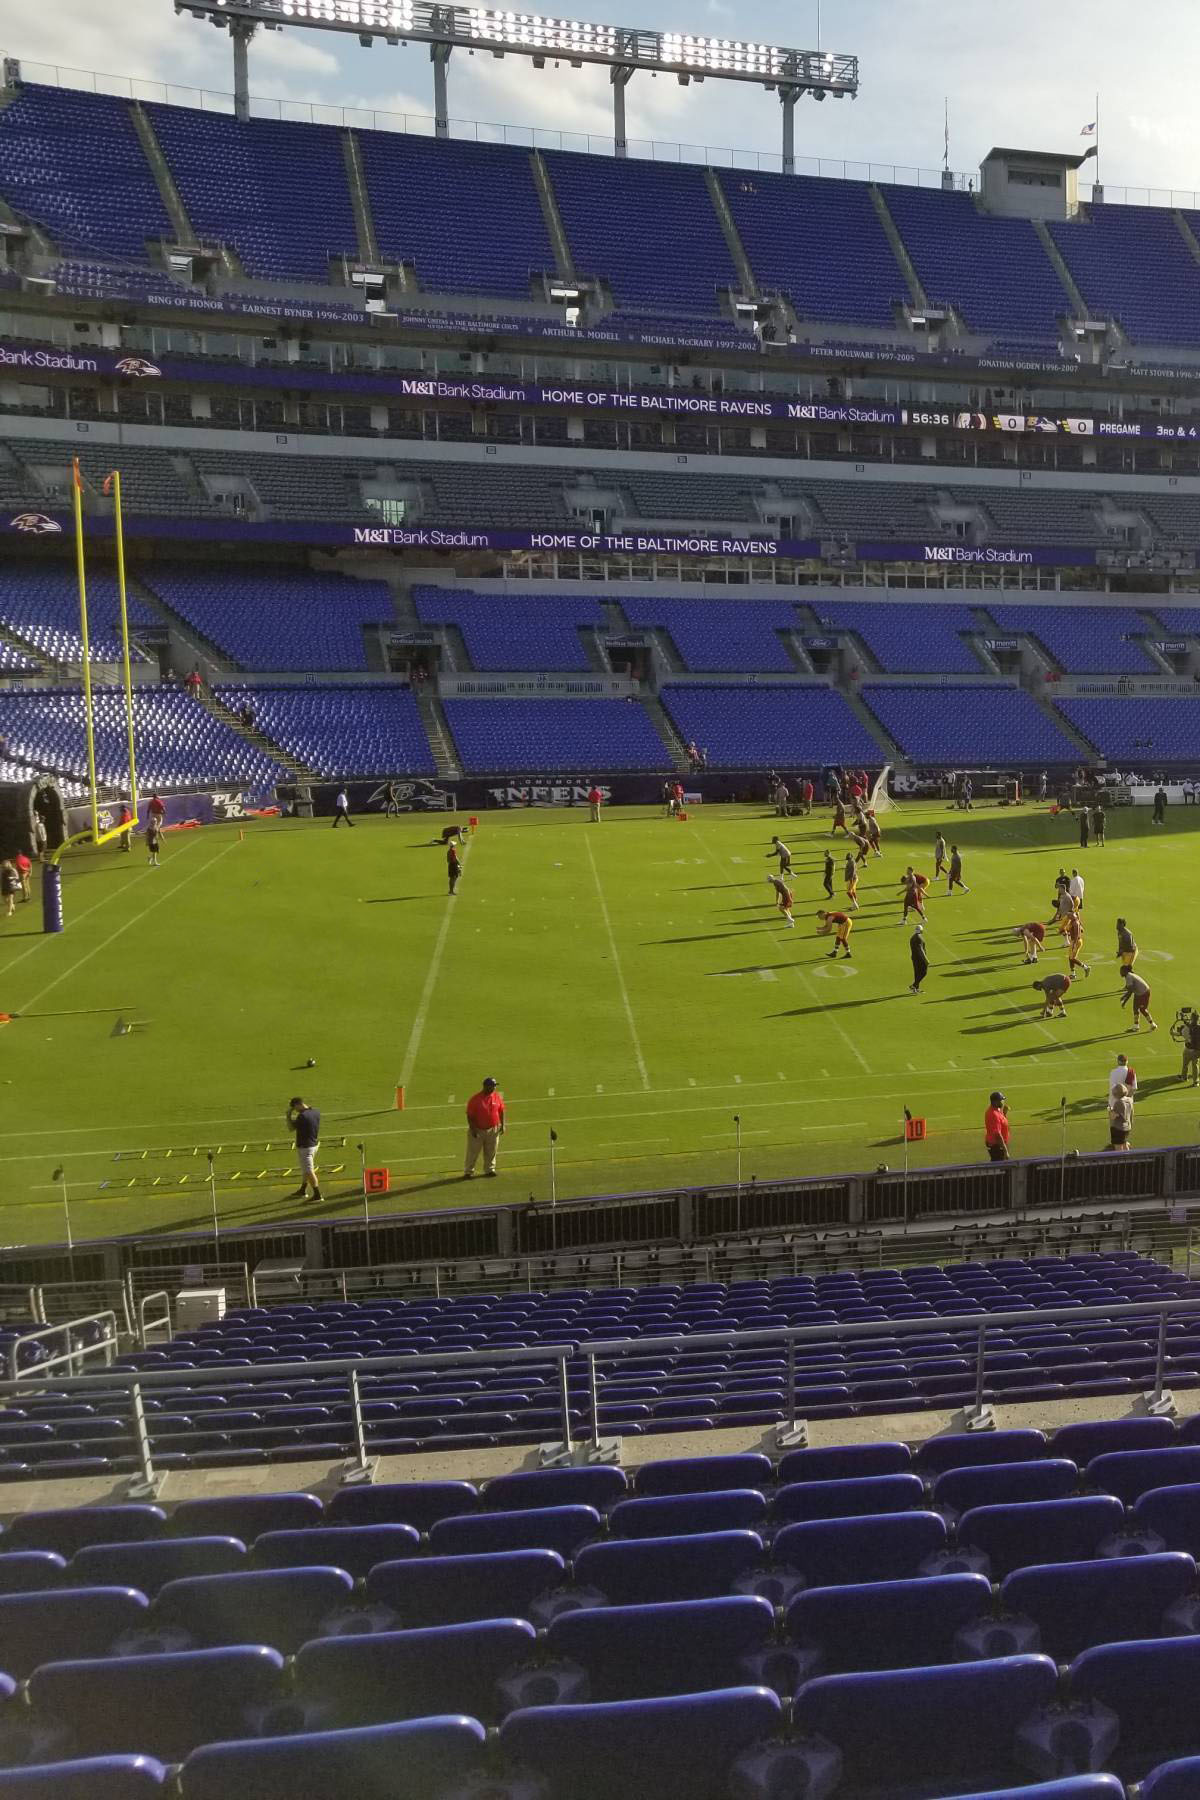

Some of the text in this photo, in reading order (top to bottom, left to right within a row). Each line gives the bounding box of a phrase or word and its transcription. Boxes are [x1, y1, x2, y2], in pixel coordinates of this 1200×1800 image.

[148, 296, 172, 305] RING
[174, 298, 188, 306] OF
[190, 299, 224, 310] HONOR
[242, 304, 364, 322] EARNEST BYNER 1996-2003
[466, 320, 500, 329] BALTIMORE
[542, 328, 620, 341] ARTHUR B. MODELL
[641, 335, 757, 350] MICHAEL McCRARY 1997-2002
[0, 348, 97, 372] Bank Stadium
[810, 348, 915, 362] PETER BOULWARE 1997-2005
[978, 360, 1078, 372] JONATHAN OGDEN 1996-2007
[1130, 368, 1148, 376] MATT
[1149, 369, 1174, 378] STOVER
[401, 380, 525, 401] M&T Bank Stadium
[542, 390, 772, 415] HOME OF THE BALTIMORE RAVENS
[788, 404, 895, 424] M&T Bank Stadium
[912, 412, 949, 424] 56:36
[1008, 418, 1017, 429] 0
[1078, 422, 1086, 433] 0
[1100, 423, 1140, 435] PREGAME
[1156, 426, 1174, 436] 3RD
[1177, 426, 1186, 436] &
[1188, 426, 1196, 437] 4
[354, 528, 488, 546] M&T Bank Stadium
[531, 534, 777, 554] HOME OF THE BALTIMORE RAVENS
[925, 546, 1032, 563] M&T Bank Stadium
[910, 1120, 923, 1137] 10
[370, 1171, 384, 1190] G
